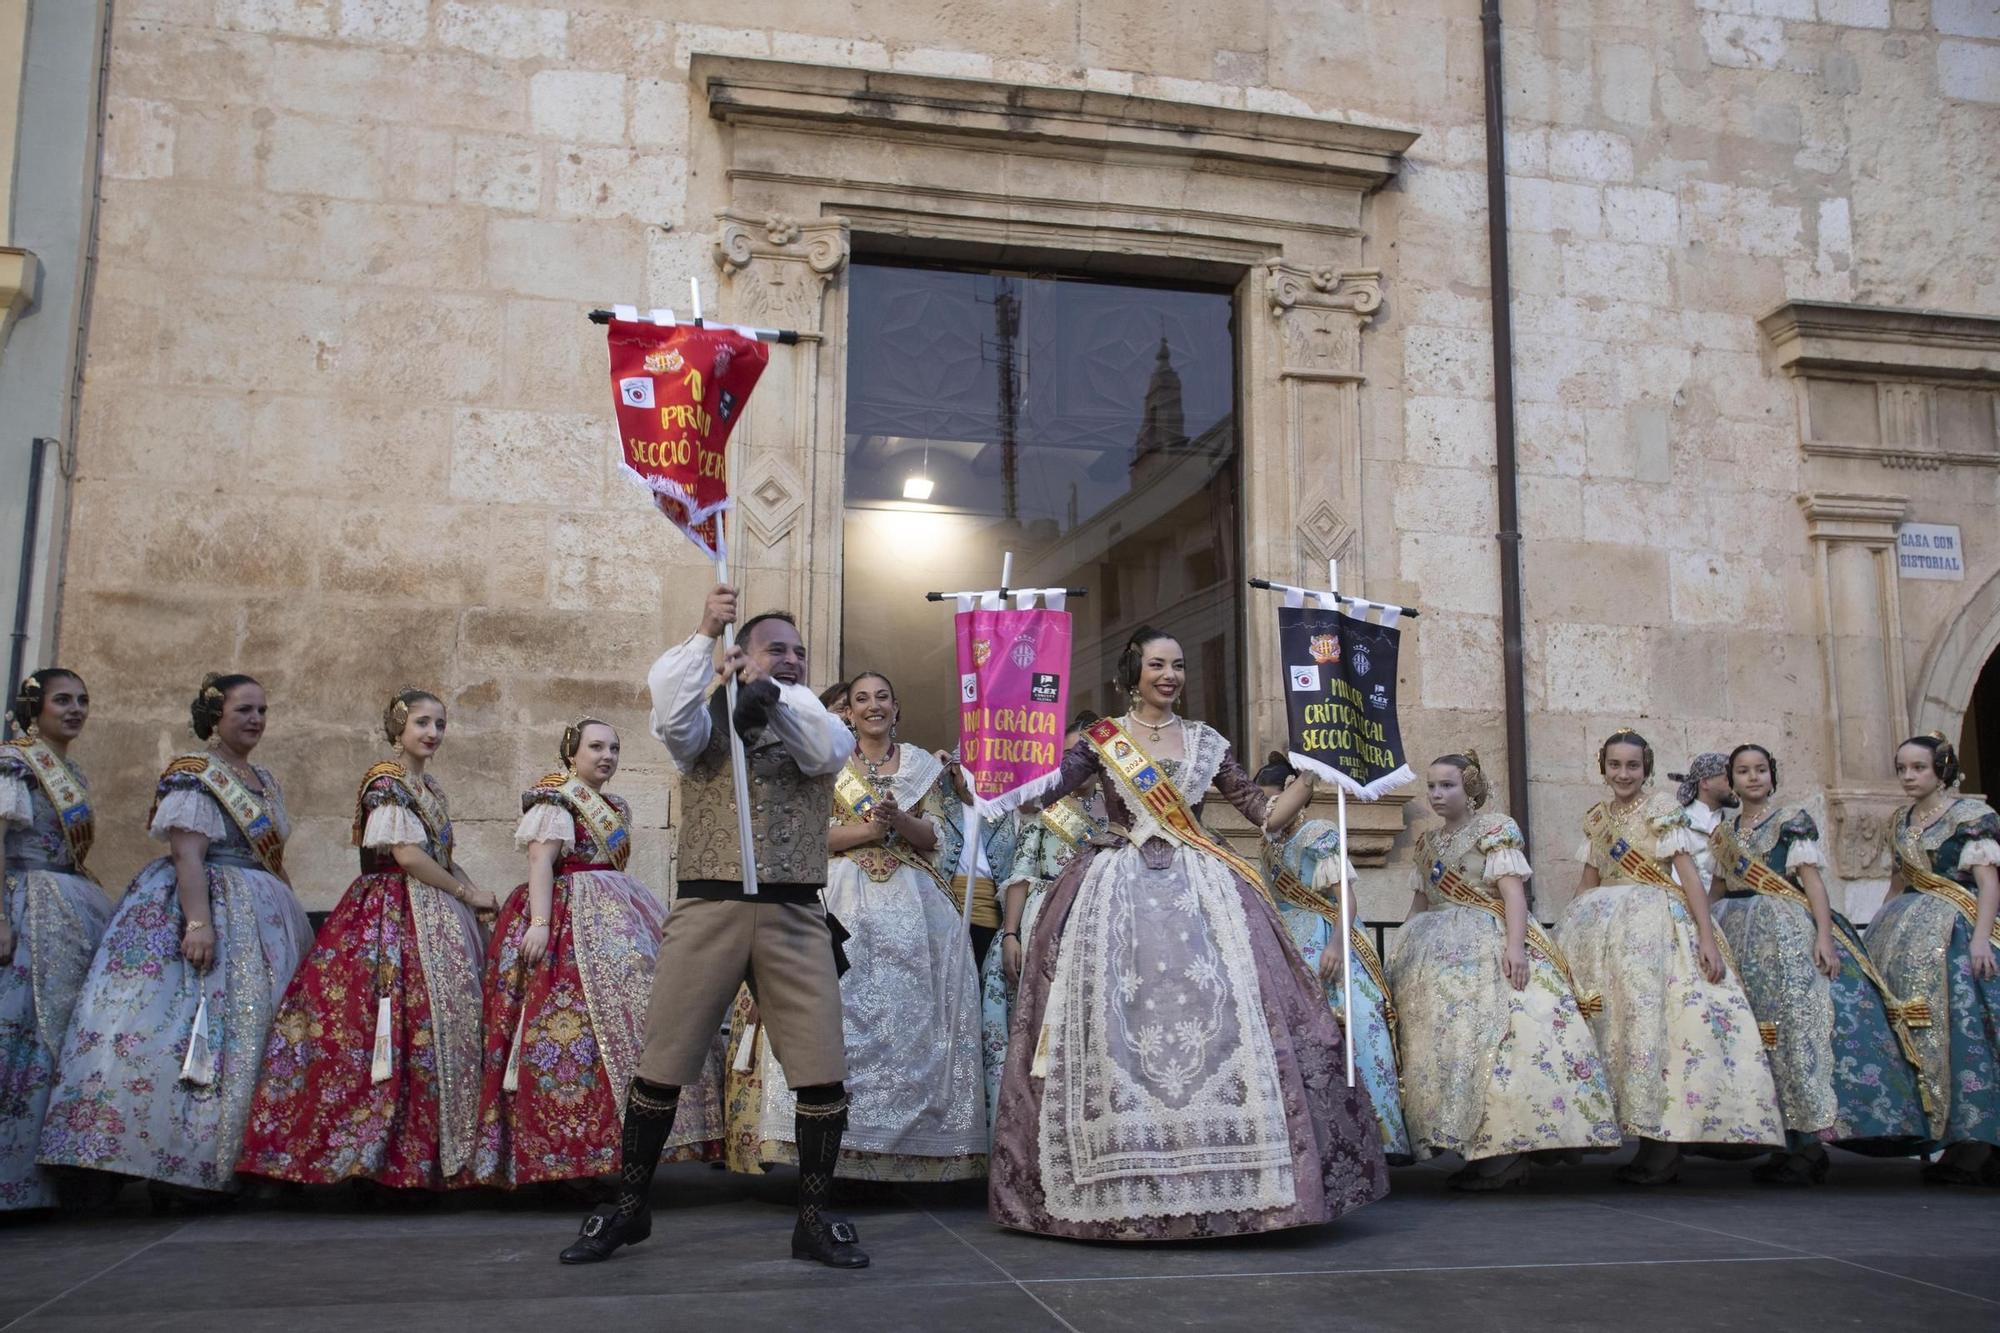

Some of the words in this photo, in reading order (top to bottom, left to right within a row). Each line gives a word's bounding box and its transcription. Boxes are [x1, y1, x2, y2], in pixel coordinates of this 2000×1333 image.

[629, 431, 691, 468] SECCIÓ
[1901, 533, 1930, 548] CASA
[1933, 535, 1954, 550] CON
[1899, 554, 1960, 571] SISTORIAL
[1032, 686, 1058, 695] FLEX
[1369, 694, 1390, 705] FLEX
[994, 705, 1056, 735] GRÀCIA
[1302, 725, 1352, 751] SECCIÓ
[983, 737, 1055, 766] TERCERA
[1124, 756, 1144, 773] 2024
[591, 805, 605, 819] 2024
